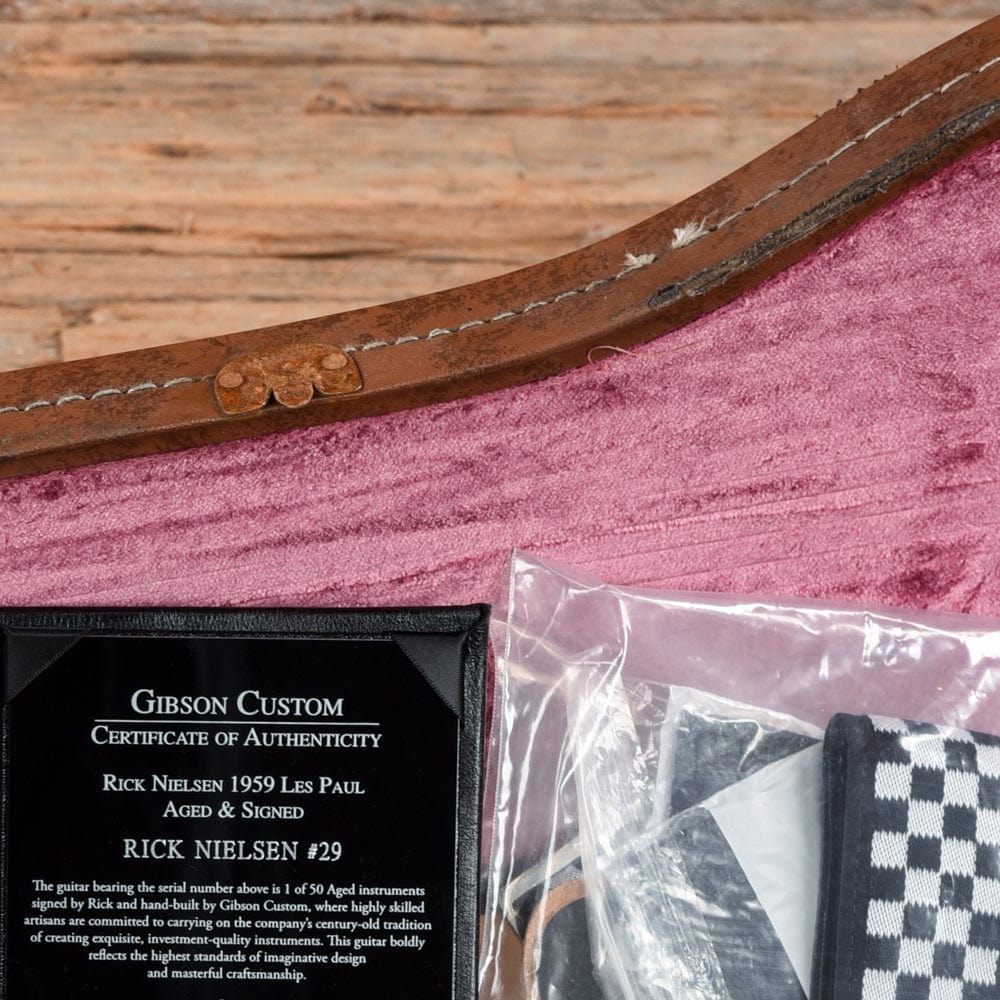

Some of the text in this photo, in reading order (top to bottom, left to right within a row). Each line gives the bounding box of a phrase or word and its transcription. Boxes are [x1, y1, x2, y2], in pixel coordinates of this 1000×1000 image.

[131, 689, 344, 716] GIBSON CUSTOM
[91, 725, 382, 748] CERTIFICATE OF AUTHENTICITY
[102, 774, 365, 794] RICK NIELSEN 1959 LES PAUL
[163, 800, 304, 819] AGED & SIGNED
[123, 839, 342, 862] RICK NIELSEN #29
[32, 879, 425, 898] The guitar bearing the serial number above is 1 of 50 Aged instruments
[147, 966, 306, 983] and masterful craftsmanship.
